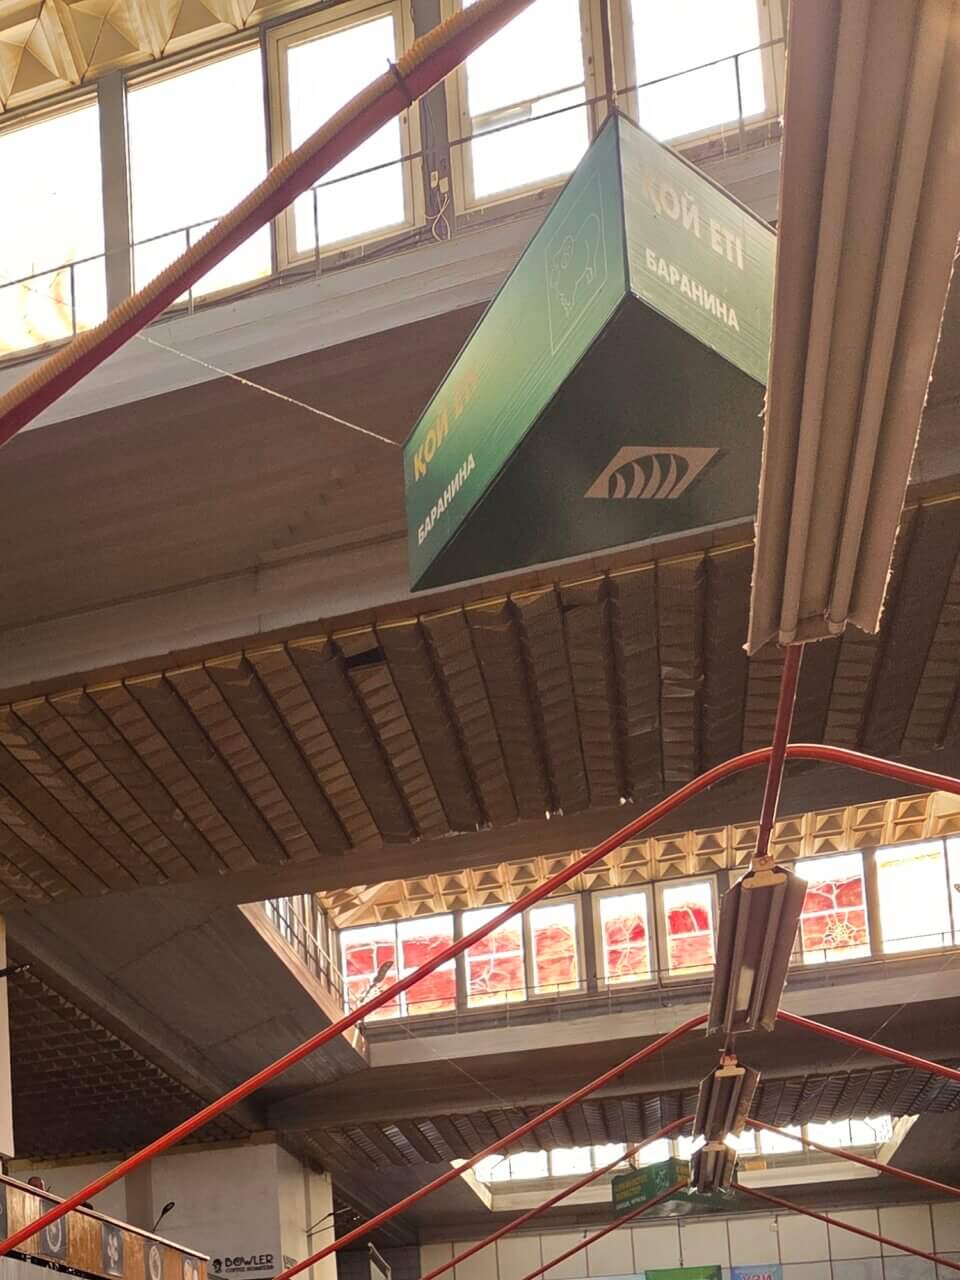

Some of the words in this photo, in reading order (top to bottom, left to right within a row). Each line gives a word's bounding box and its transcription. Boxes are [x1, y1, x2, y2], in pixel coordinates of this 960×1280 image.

[646, 247, 740, 331] БАРАНИНА
[417, 452, 476, 545] БАРАНИНА
[224, 1253, 274, 1267] BOWLER
